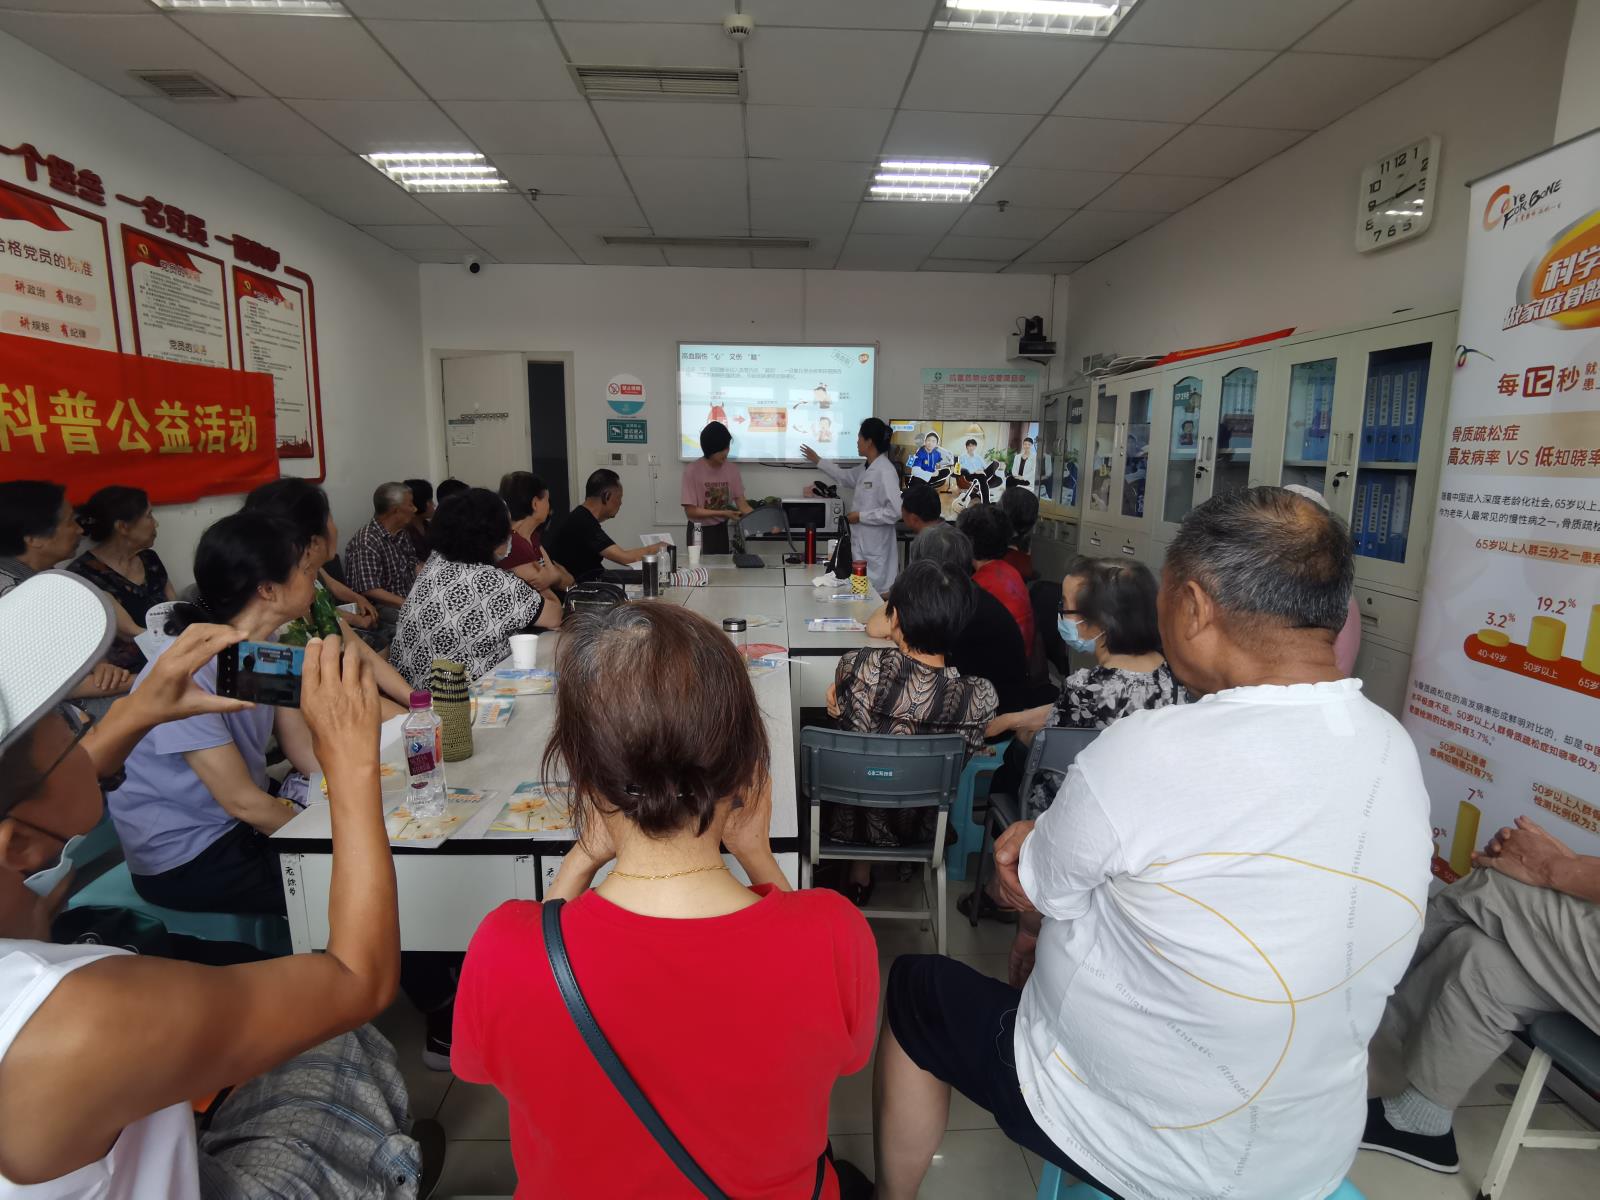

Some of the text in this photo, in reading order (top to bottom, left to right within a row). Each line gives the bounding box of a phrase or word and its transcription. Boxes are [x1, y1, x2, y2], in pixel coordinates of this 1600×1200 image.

[1380, 157, 1390, 174] 11
[1394, 153, 1408, 169] 12
[1369, 179, 1382, 194] 10
[0, 385, 257, 454] 科普公益活动
[1452, 424, 1520, 443] 骨质疏松症
[1447, 447, 1500, 466] 高发病率
[1506, 450, 1530, 466] VS
[1485, 612, 1516, 628] 3.2%
[1523, 661, 1560, 680] 50岁以上
[1467, 787, 1484, 801] 7%
